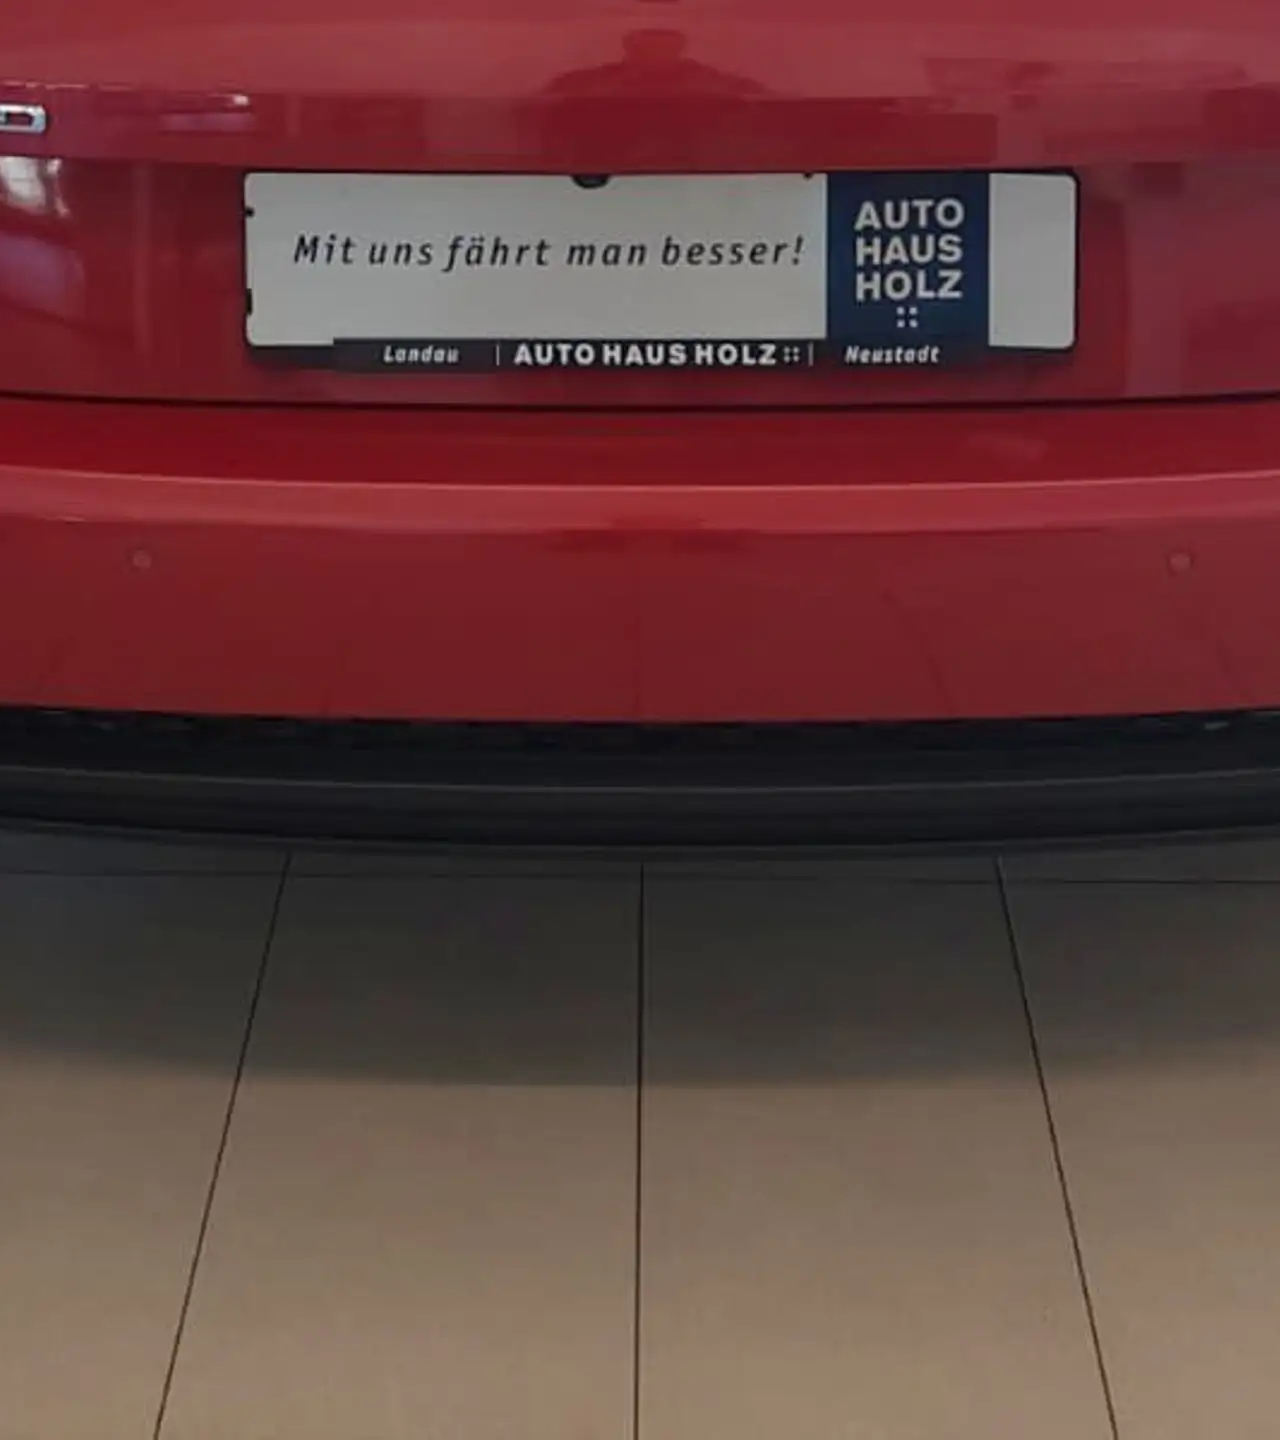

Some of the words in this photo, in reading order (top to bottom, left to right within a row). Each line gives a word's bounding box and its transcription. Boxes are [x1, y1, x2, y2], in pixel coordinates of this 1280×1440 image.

[854, 198, 965, 230] AUTO
[294, 233, 357, 264] Mit
[368, 242, 433, 266] uns
[442, 235, 551, 273] fährt
[566, 243, 648, 266] man
[661, 234, 804, 266] besser!
[855, 233, 964, 266] HAUS
[855, 269, 963, 301] HOLZ
[383, 345, 459, 364] Landau
[845, 345, 940, 364] Neustadt
